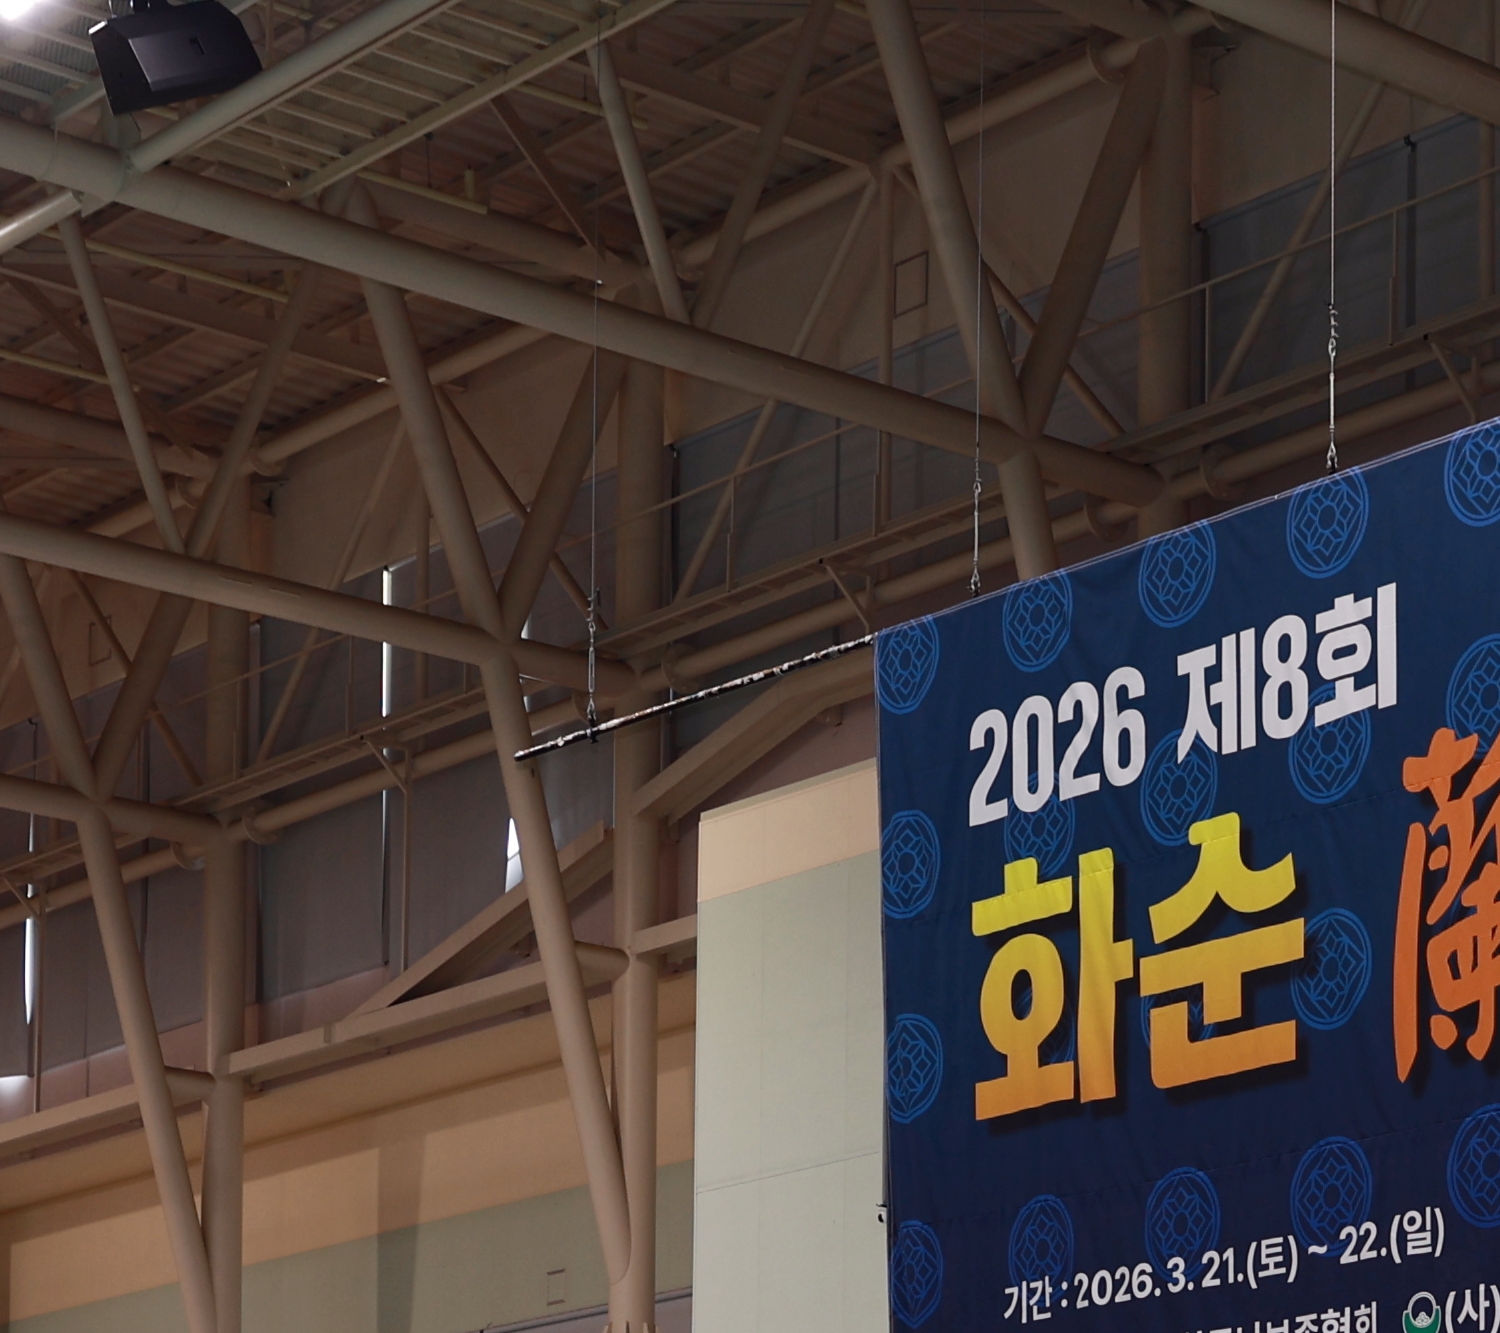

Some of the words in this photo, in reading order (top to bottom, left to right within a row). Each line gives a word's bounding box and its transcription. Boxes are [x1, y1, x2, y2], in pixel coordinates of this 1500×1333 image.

[968, 663, 1146, 828] 2026
[1175, 582, 1398, 766] 제8회
[971, 811, 1306, 1122] 화순
[1004, 1276, 1052, 1324] 기간
[1201, 1235, 1298, 1289] 21.(토)
[1339, 1206, 1445, 1264] 22.(일)
